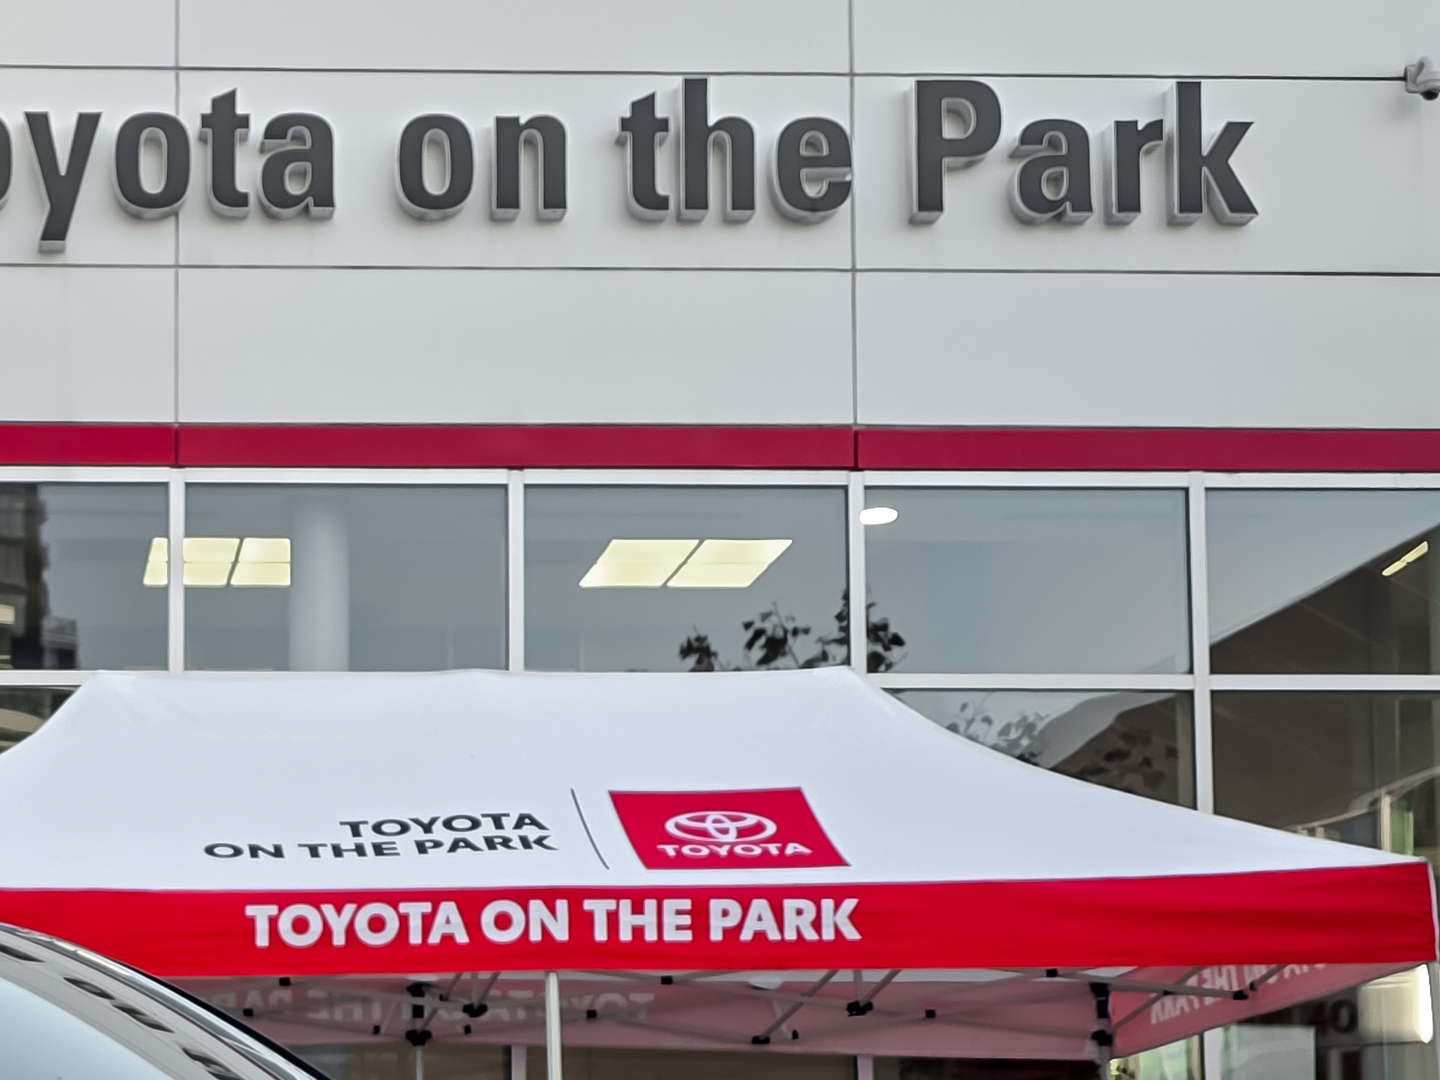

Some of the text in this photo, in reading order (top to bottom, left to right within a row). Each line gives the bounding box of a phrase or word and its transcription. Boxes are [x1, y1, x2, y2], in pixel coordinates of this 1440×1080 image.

[397, 113, 568, 224] on
[615, 77, 854, 226] the
[908, 79, 1260, 228] Park
[339, 812, 550, 839] TOYOTA
[203, 834, 559, 859] ON THE PARK
[656, 841, 813, 858] TOYOTA
[244, 897, 863, 948] TOYOTA ON THE PARK
